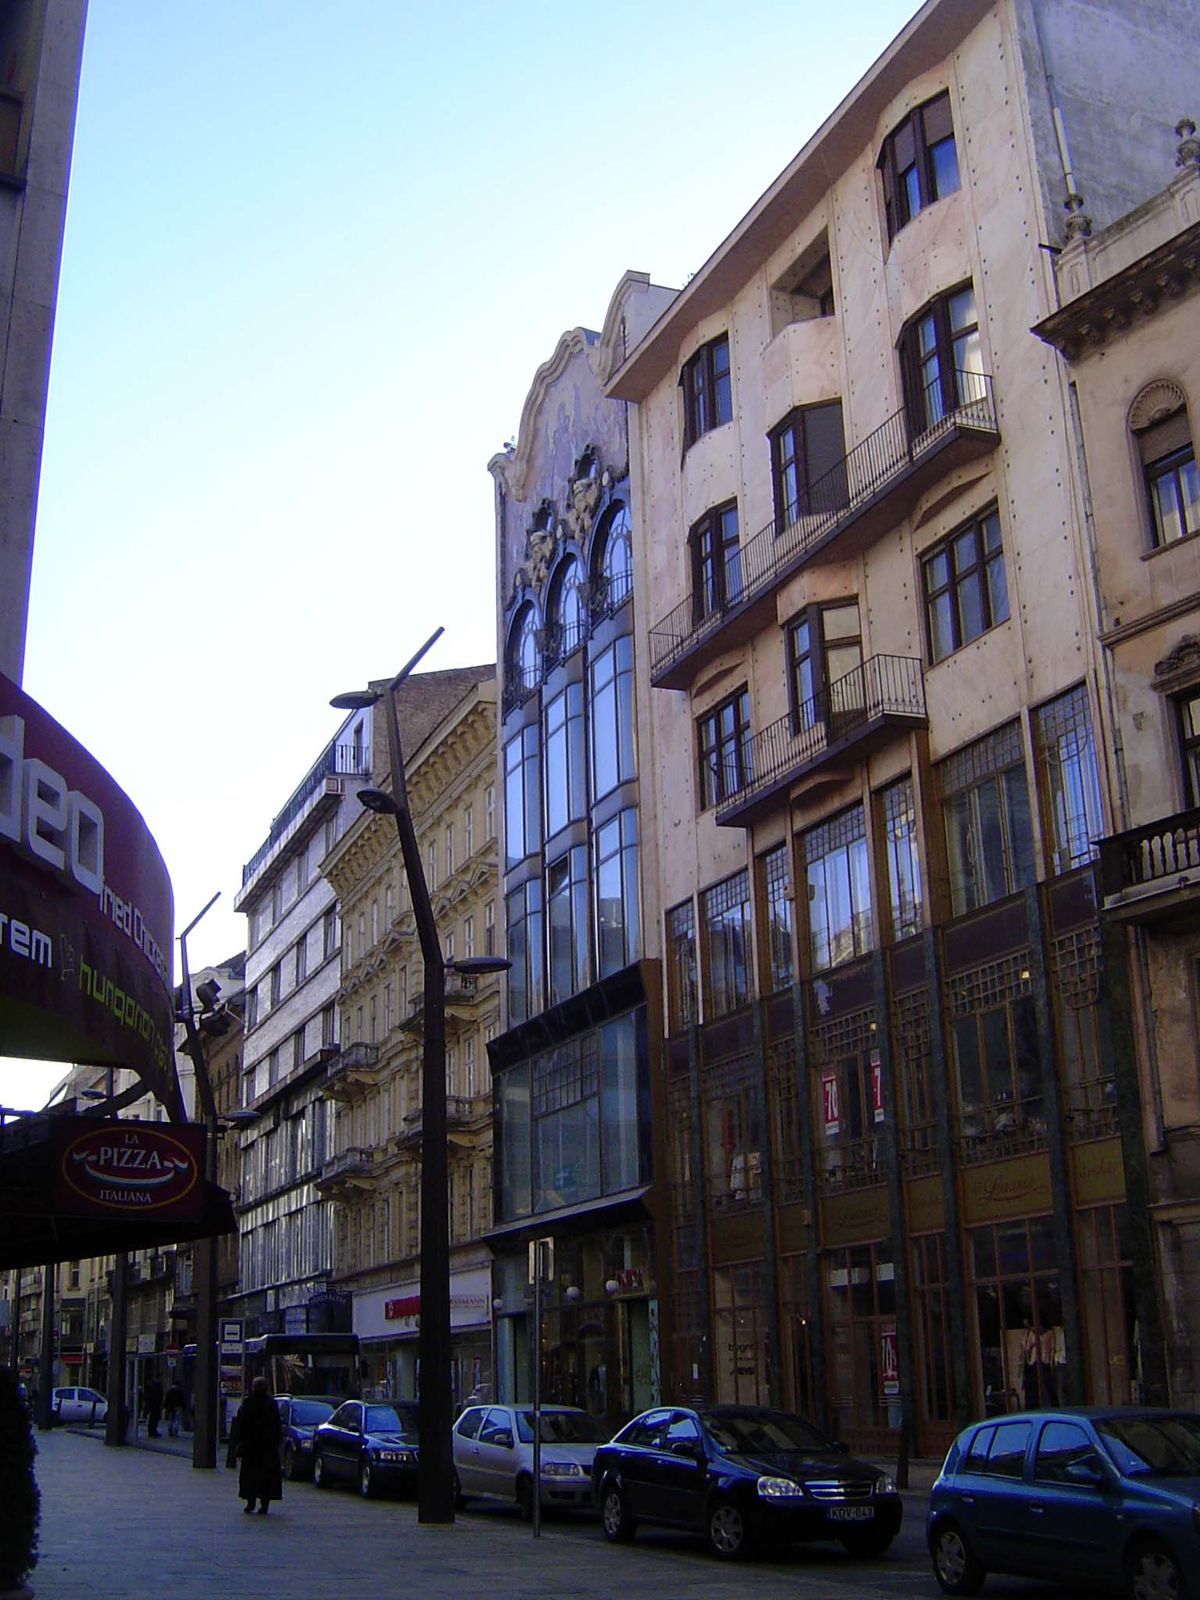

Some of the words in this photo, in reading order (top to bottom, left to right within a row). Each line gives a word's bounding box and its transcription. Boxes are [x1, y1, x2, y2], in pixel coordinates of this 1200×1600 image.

[124, 1133, 140, 1145] LA
[98, 1146, 162, 1170] PIZZA
[100, 1189, 152, 1203] ITALIANA
